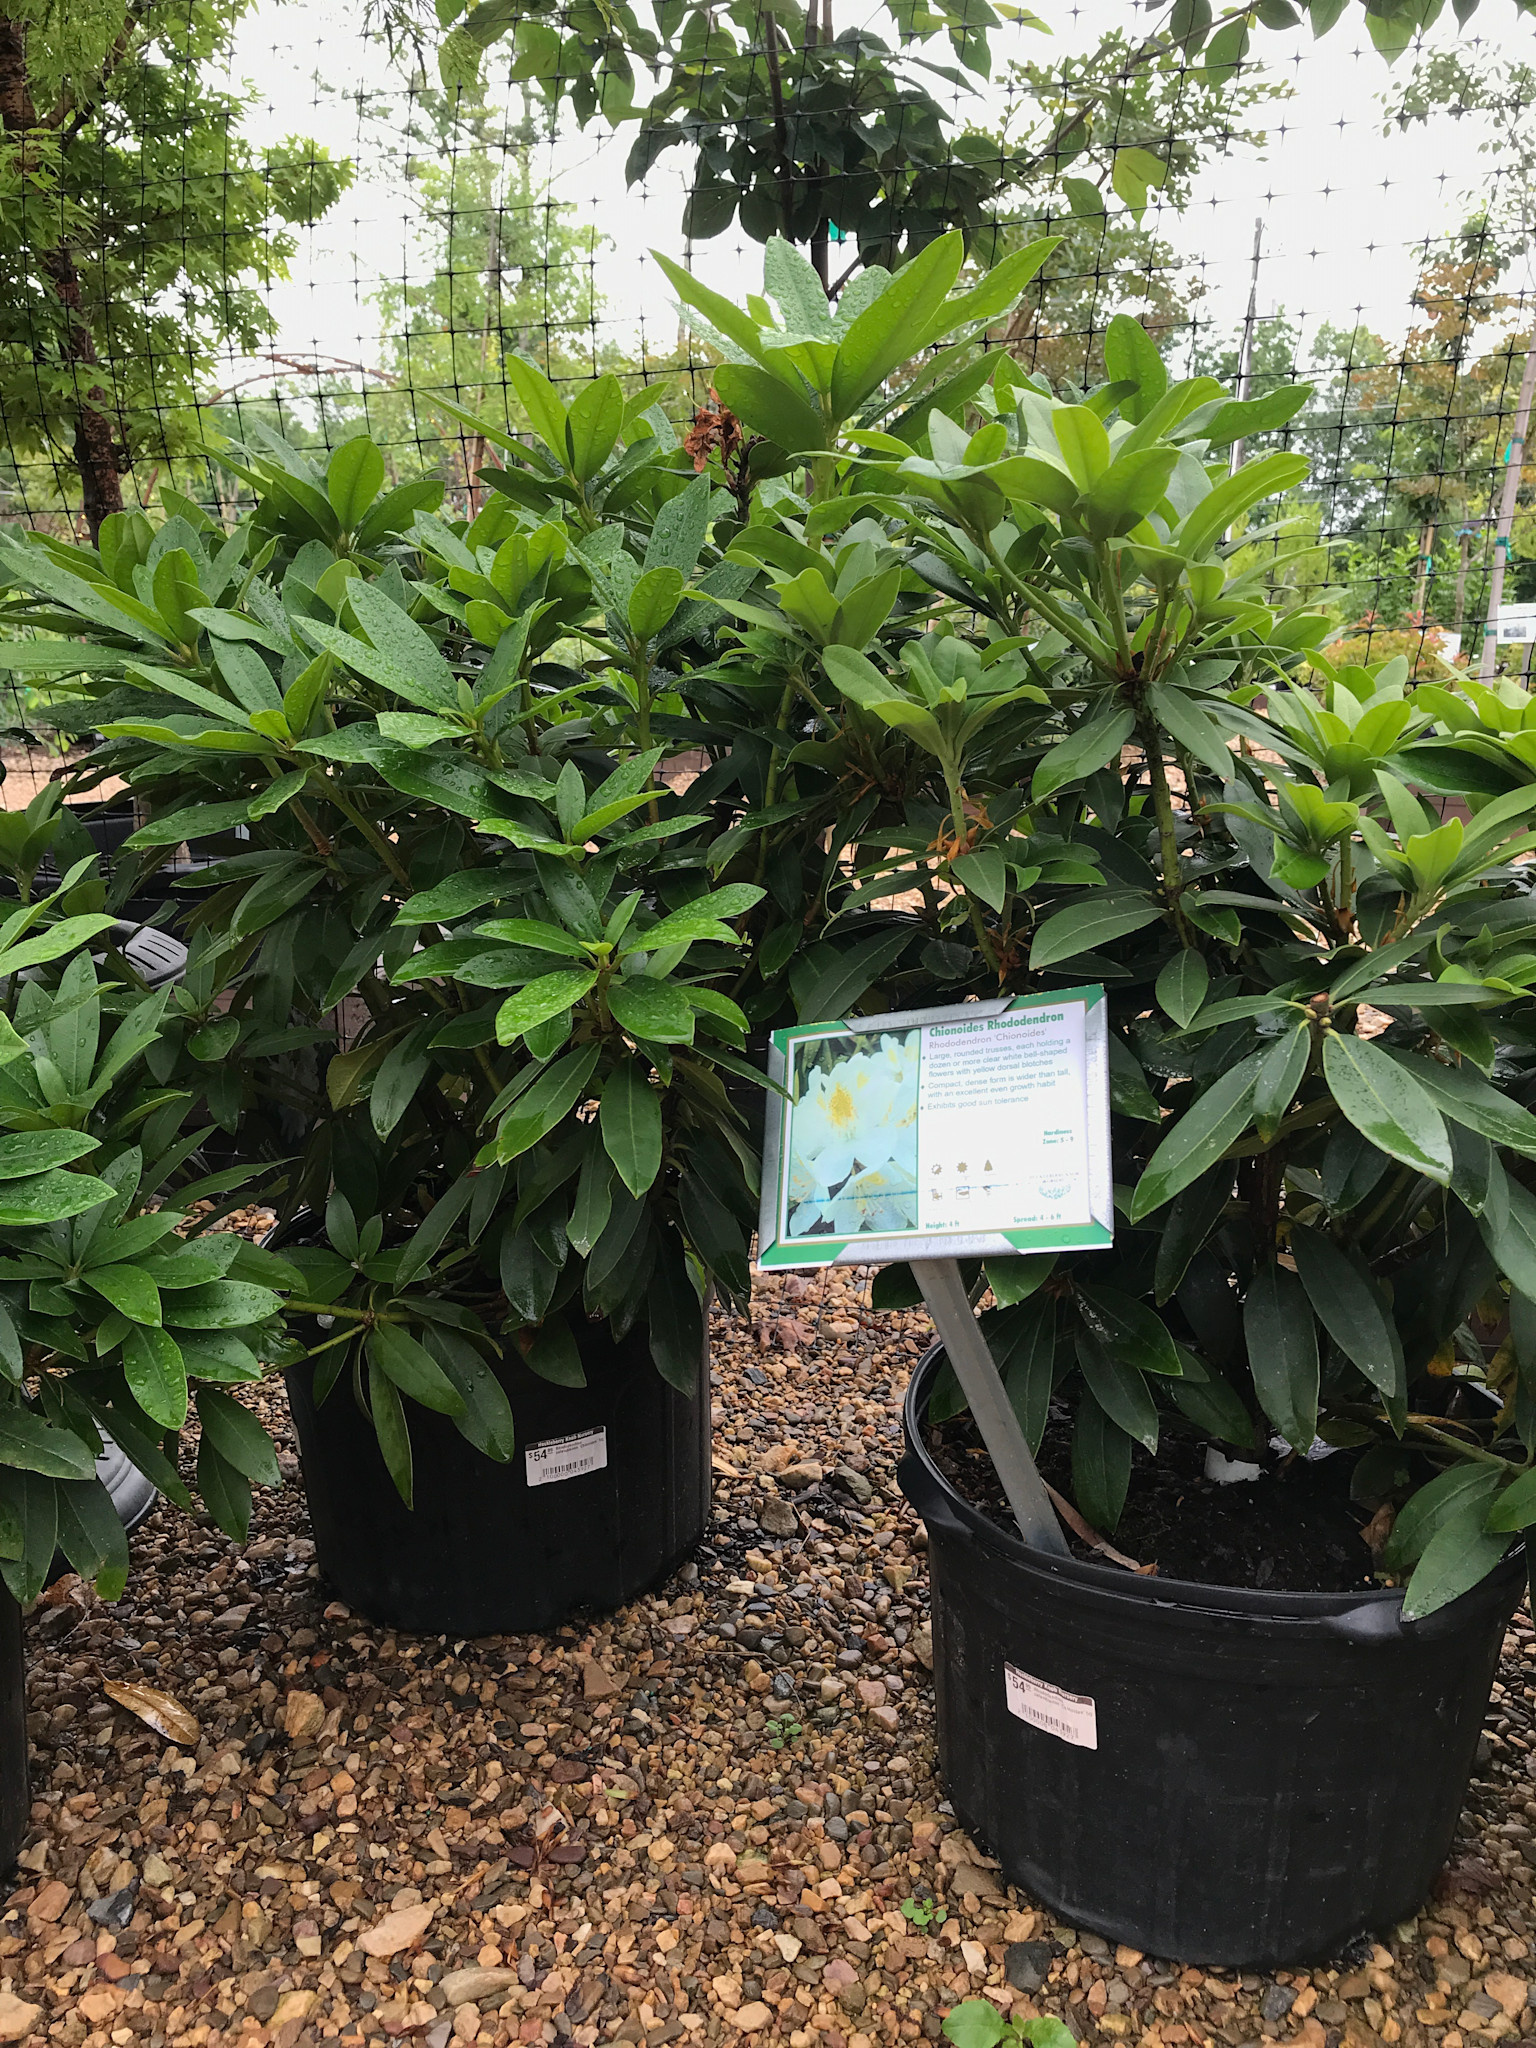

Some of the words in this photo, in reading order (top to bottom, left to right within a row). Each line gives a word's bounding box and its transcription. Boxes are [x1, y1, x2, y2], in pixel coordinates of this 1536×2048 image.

[929, 1022, 984, 1037] Chionoides
[987, 1012, 1064, 1030] Rhododendron
[929, 1036, 992, 1049] Rhododendron
[994, 1028, 1047, 1041] 'Chionoides'
[929, 1052, 951, 1061] Large,
[954, 1048, 984, 1058] rounded
[985, 1045, 1014, 1055] trusses,
[1016, 1042, 1035, 1050] each
[1037, 1037, 1064, 1047] holding
[928, 1070, 954, 1078] flowers
[956, 1067, 971, 1075] with
[973, 1066, 996, 1075] yellow
[997, 1062, 1020, 1071] dorsal
[1022, 1059, 1053, 1068] blotches
[929, 1061, 951, 1069] dozen
[962, 1058, 981, 1066] more
[983, 1056, 1000, 1064] clear
[1002, 1053, 1022, 1061] white
[1024, 1047, 1068, 1059] bell-shaped
[928, 1081, 963, 1089] Compact,
[965, 1078, 988, 1086] dense
[1016, 1072, 1036, 1081] wider
[1038, 1071, 1056, 1079] than
[1057, 1068, 1071, 1076] tall,
[955, 1087, 988, 1096] excellent
[1009, 1082, 1035, 1092] growth
[1037, 1080, 1056, 1088] habit
[927, 1101, 956, 1110] Exhibits
[957, 1100, 977, 1109] good
[994, 1096, 1029, 1105] tolerance
[1013, 1215, 1038, 1223] Spread:
